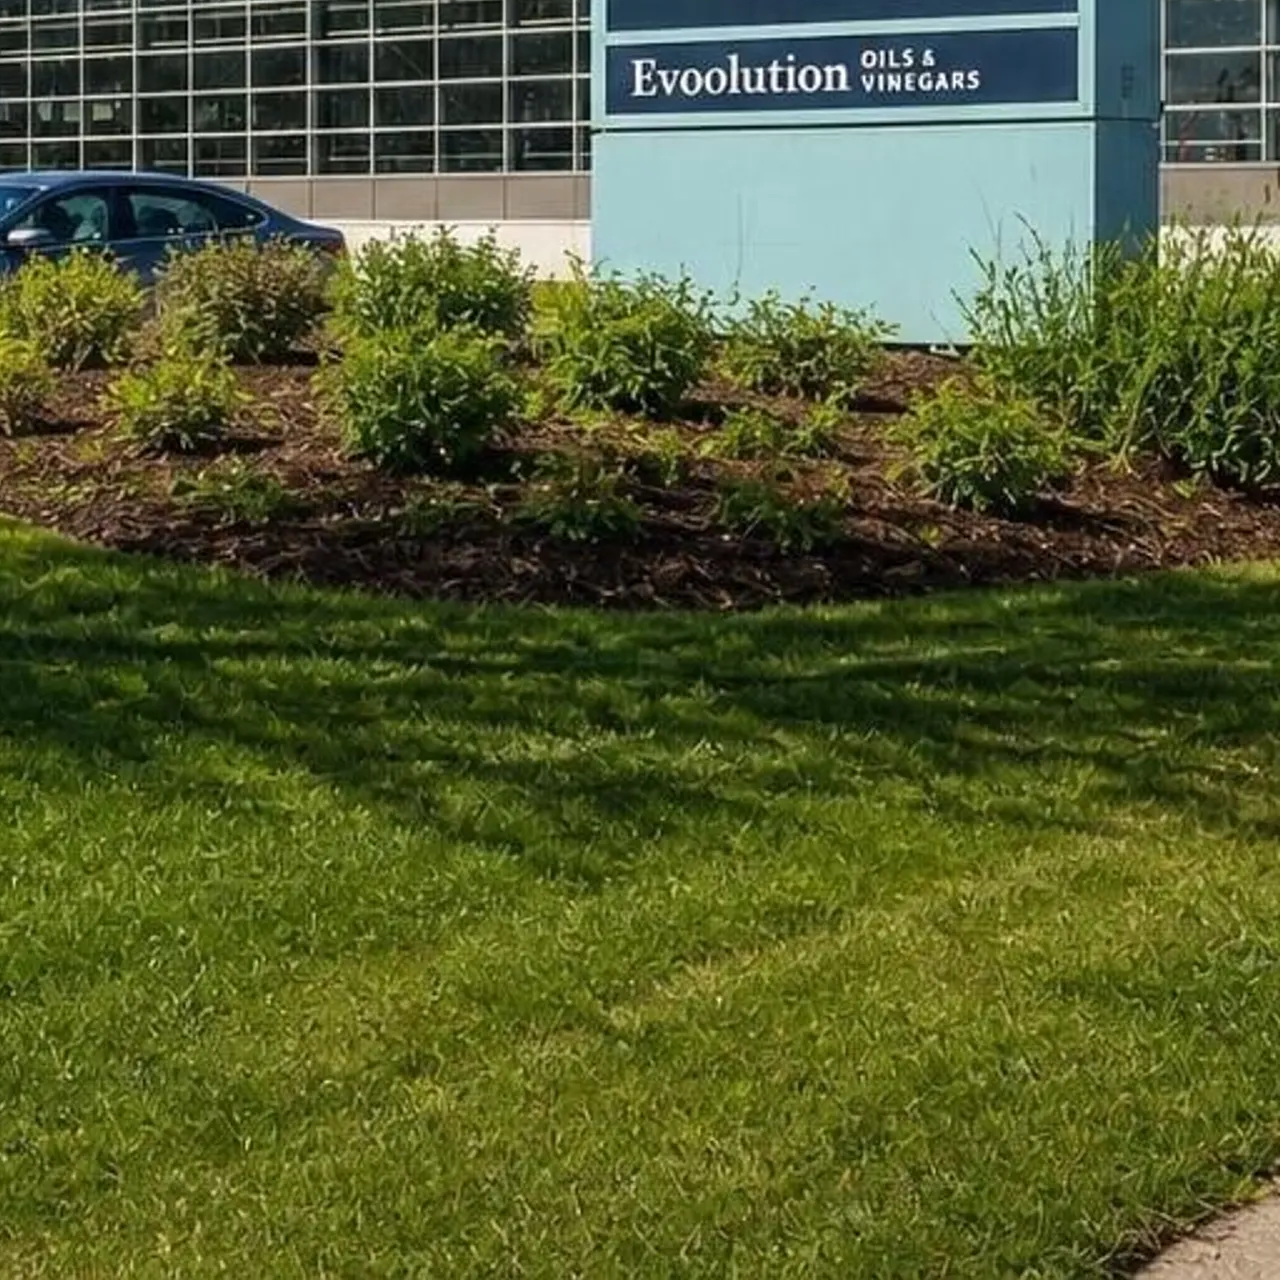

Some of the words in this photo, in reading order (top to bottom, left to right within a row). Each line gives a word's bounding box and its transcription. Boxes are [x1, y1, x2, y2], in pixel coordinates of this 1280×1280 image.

[861, 47, 914, 69] OILS
[922, 48, 936, 67] &
[630, 55, 849, 97] Evoolution
[861, 70, 980, 93] VINEGARS
